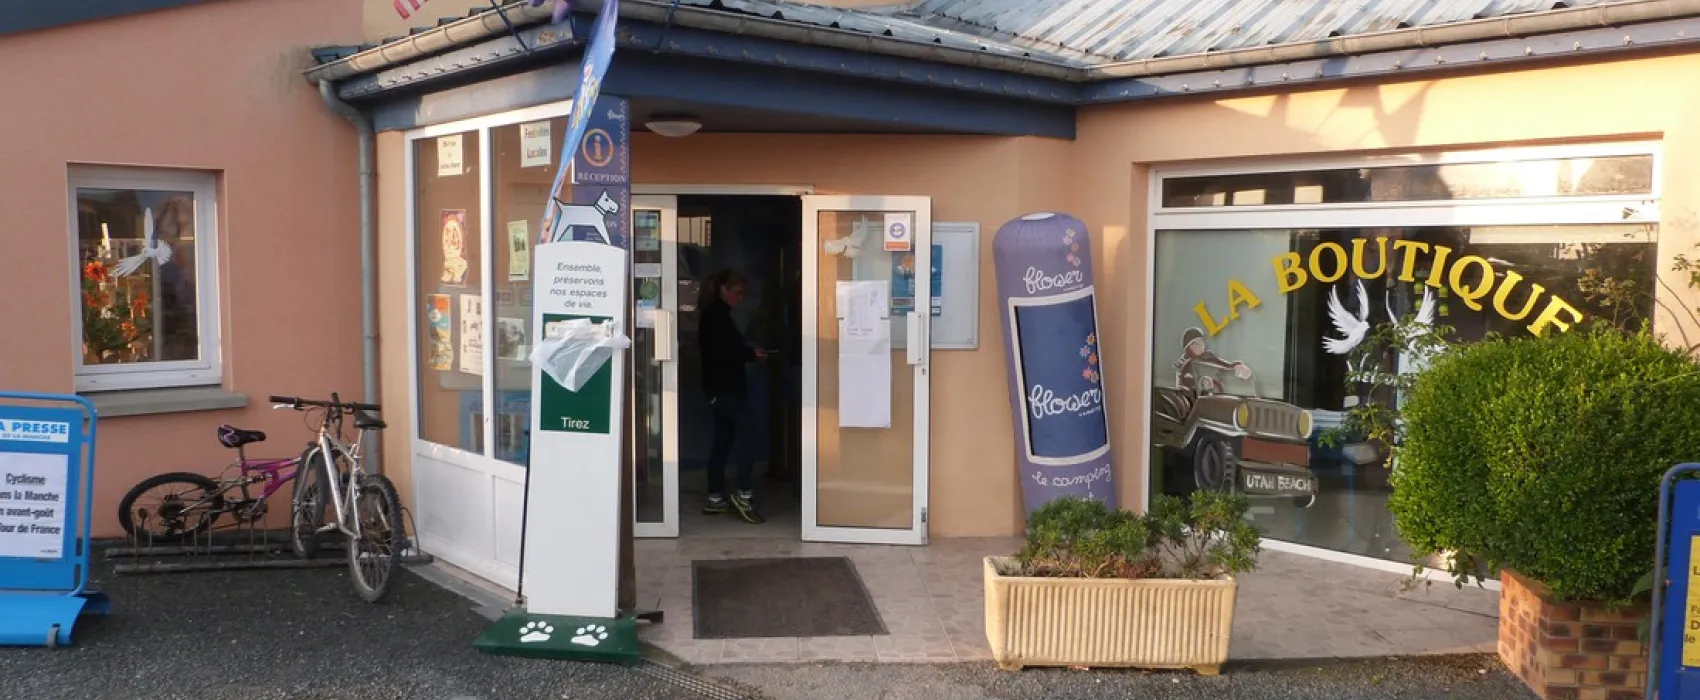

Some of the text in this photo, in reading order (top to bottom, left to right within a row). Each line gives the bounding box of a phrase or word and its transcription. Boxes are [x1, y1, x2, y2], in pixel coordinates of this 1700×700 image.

[556, 262, 602, 274] Ensemble,
[553, 276, 605, 286] préservons
[1022, 266, 1083, 294] flower
[549, 288, 608, 298] nos espaces
[1193, 236, 1583, 338] LA BOUTIQUE
[564, 300, 576, 308] de
[1027, 384, 1101, 419] flower
[12, 421, 67, 434] PRESSE
[561, 416, 590, 430] Tirez
[6, 472, 46, 485] Cyclisme
[1031, 463, 1112, 490] le camping
[1246, 474, 1312, 492] UTAH BEACH
[14, 490, 22, 500] la
[24, 490, 60, 501] Manche
[6, 507, 55, 520] avant-goût
[17, 524, 29, 534] de
[31, 524, 61, 535] France
